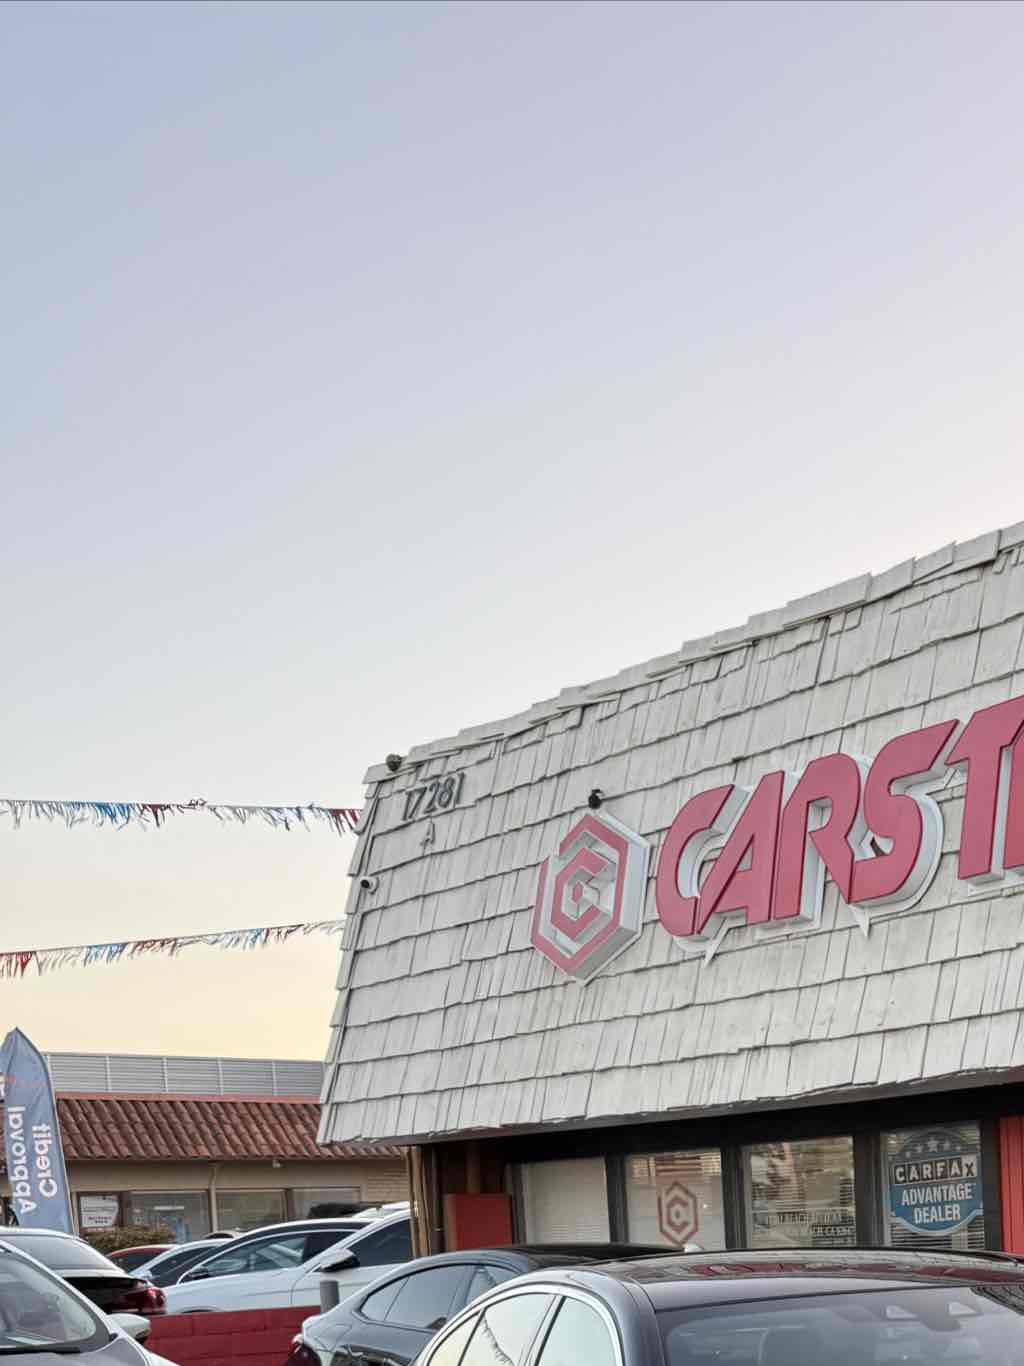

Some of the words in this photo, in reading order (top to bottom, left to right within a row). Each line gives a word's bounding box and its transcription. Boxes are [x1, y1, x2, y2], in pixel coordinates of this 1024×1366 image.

[402, 772, 466, 821] 17281
[895, 1161, 974, 1182] CARFAX
[902, 1183, 973, 1206] ADVANTAGE
[914, 1204, 961, 1224] DEALER
